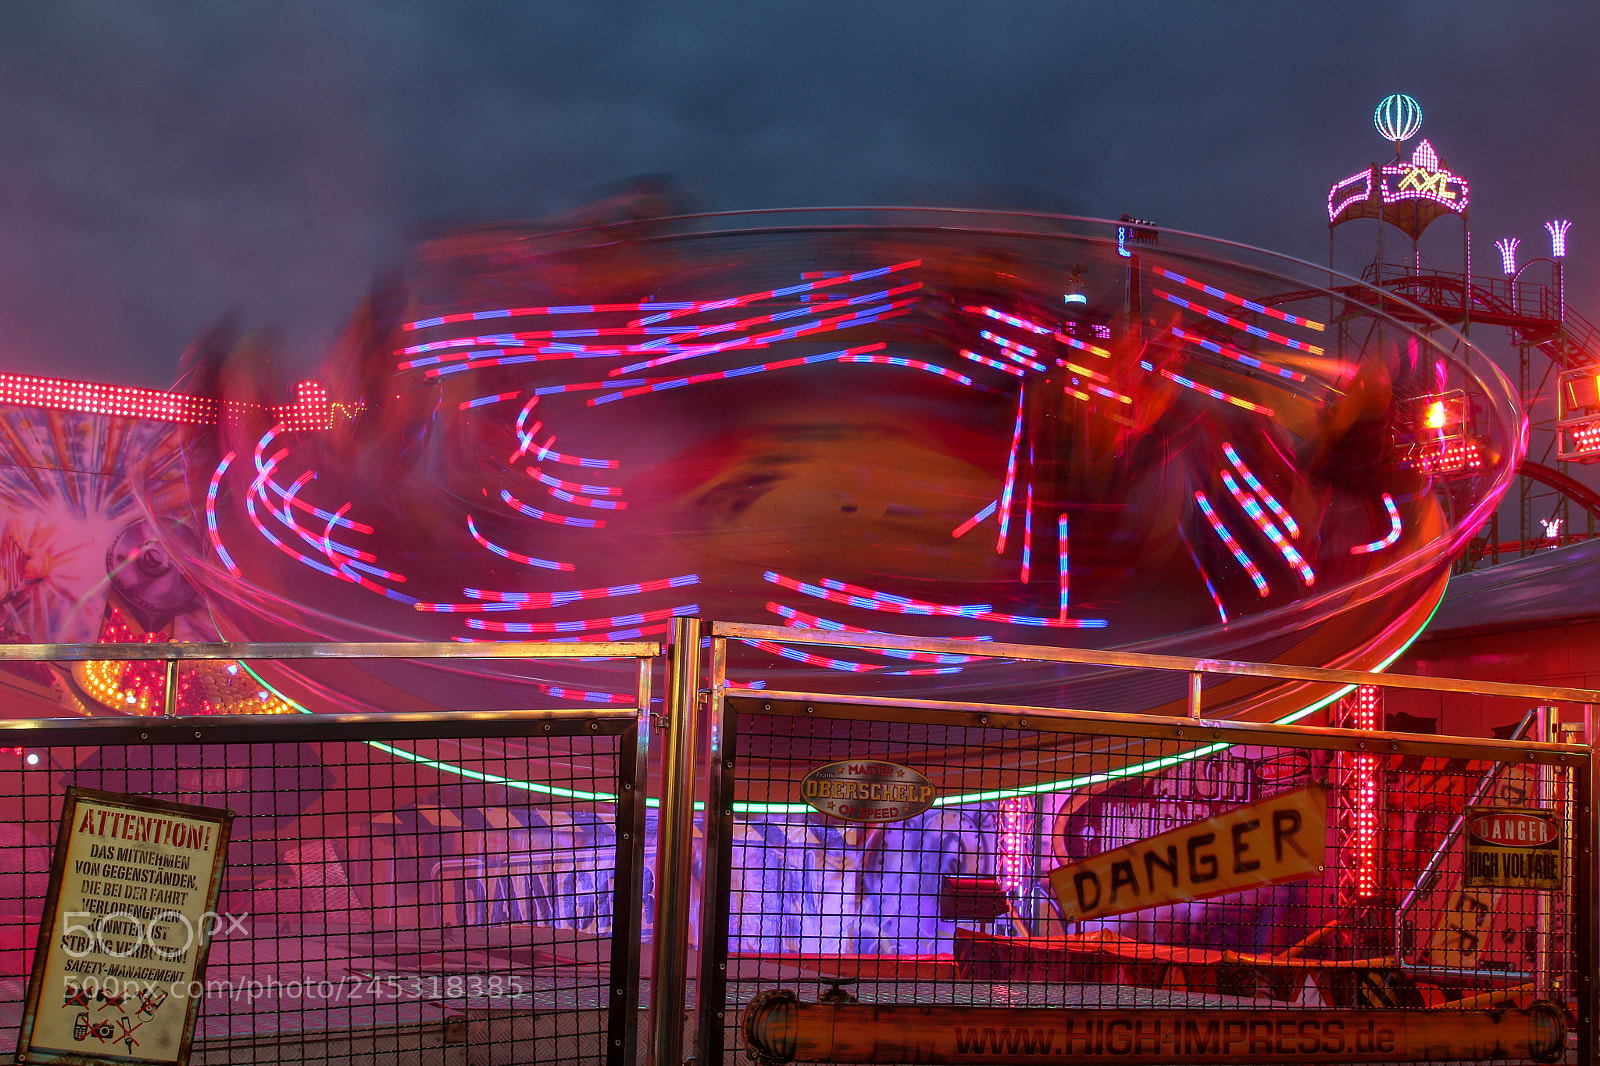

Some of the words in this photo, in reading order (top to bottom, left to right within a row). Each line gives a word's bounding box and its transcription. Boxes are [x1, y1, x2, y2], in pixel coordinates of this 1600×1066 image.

[816, 771, 835, 779] Frank
[848, 765, 894, 778] MASTER
[806, 780, 931, 803] OBERSCHELP
[838, 804, 857, 817] OF
[860, 807, 899, 819] SPEED
[79, 809, 211, 851] ATTENTION!
[1480, 819, 1548, 842] DANGER
[90, 844, 114, 860] DAS
[117, 847, 191, 870] MITNEHMEN
[1073, 809, 1308, 913] DANGER
[1469, 852, 1499, 878] HIGH
[1502, 853, 1558, 879] VOLTAGE
[75, 860, 100, 876] VON
[102, 864, 198, 891] GEGENSTÄNDEN,
[81, 880, 102, 896] DIE
[103, 882, 122, 898] BEI
[124, 884, 147, 901] DER
[150, 889, 188, 906] FAHRT
[82, 898, 181, 923] VERLORENGEHEN
[151, 925, 170, 940] IST
[60, 935, 113, 953] STRENG
[116, 941, 188, 964] VERBOTEN!
[64, 959, 186, 983] SAFETY-MANAGEMENT
[954, 1019, 1395, 1056] www.HIGH-IMPRESS.de
